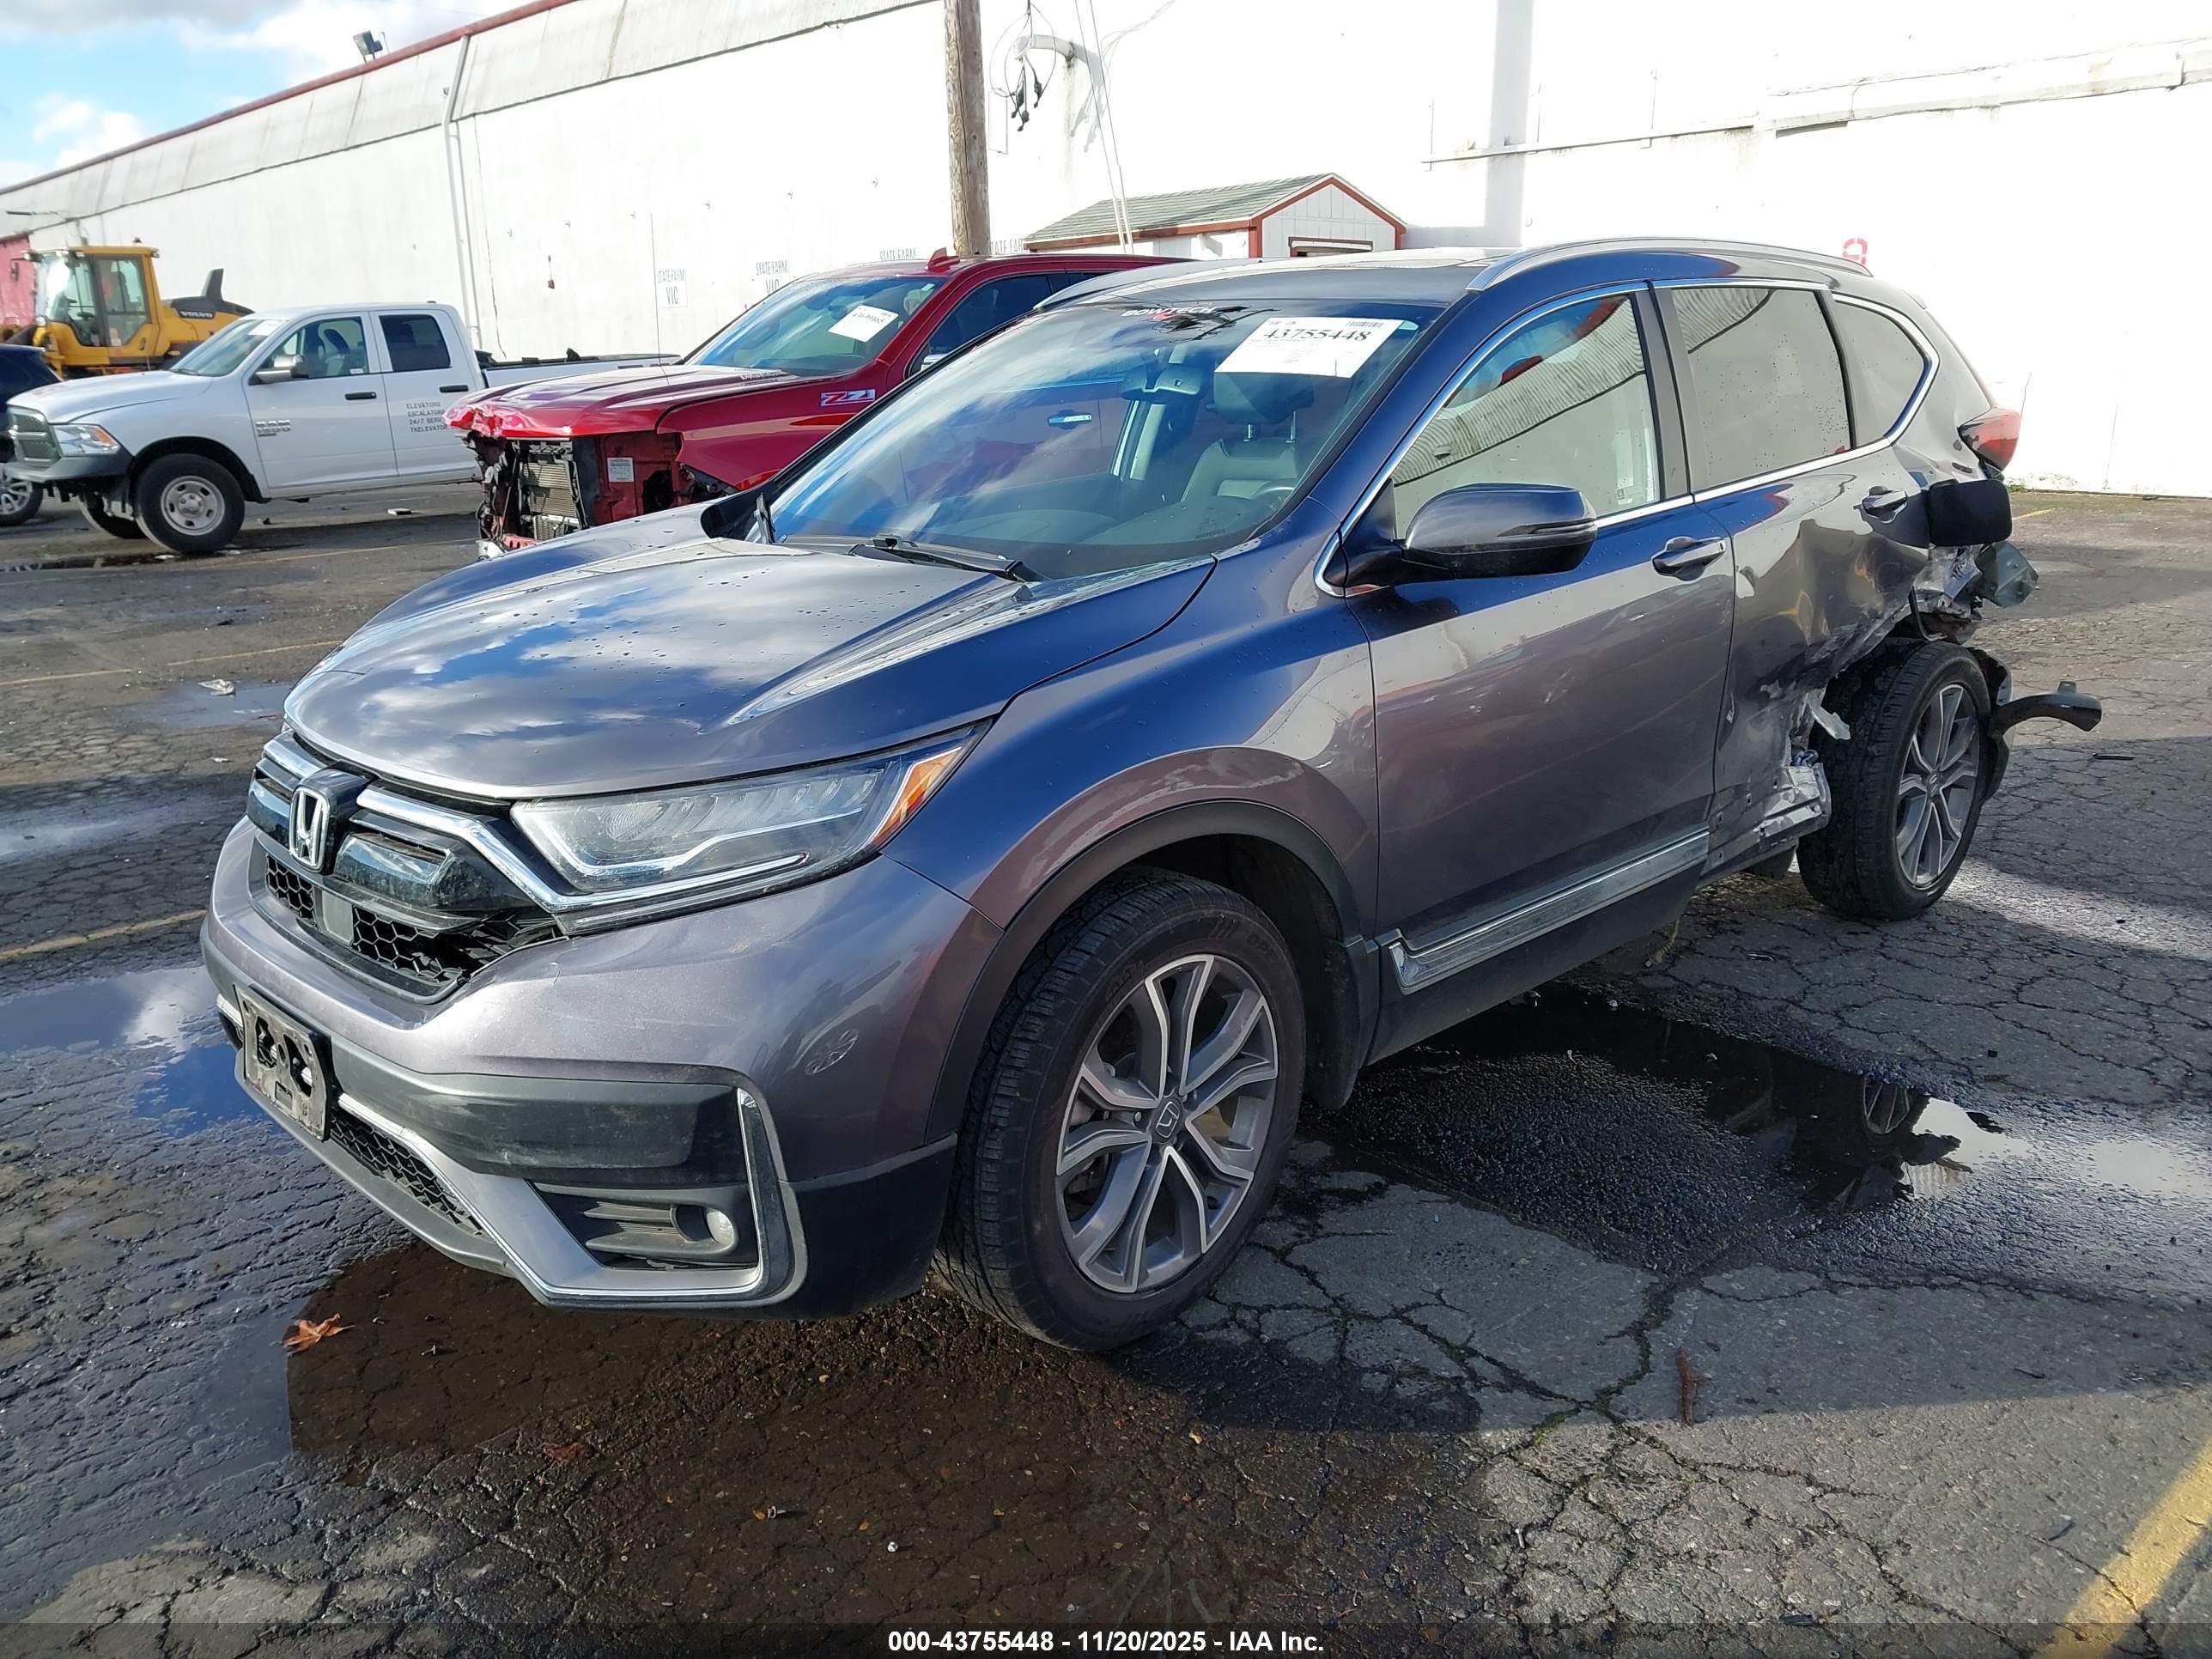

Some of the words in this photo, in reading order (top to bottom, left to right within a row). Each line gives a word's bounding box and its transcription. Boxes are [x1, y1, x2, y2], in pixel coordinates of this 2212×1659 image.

[879, 249, 896, 261] STATE
[756, 261, 771, 276] STATE
[772, 260, 788, 275] FARM
[658, 270, 672, 283] STATE
[672, 268, 684, 283] FARM
[666, 286, 678, 305] VIC
[1121, 307, 1216, 317] BOWTECH
[1263, 328, 1372, 341] 43755448
